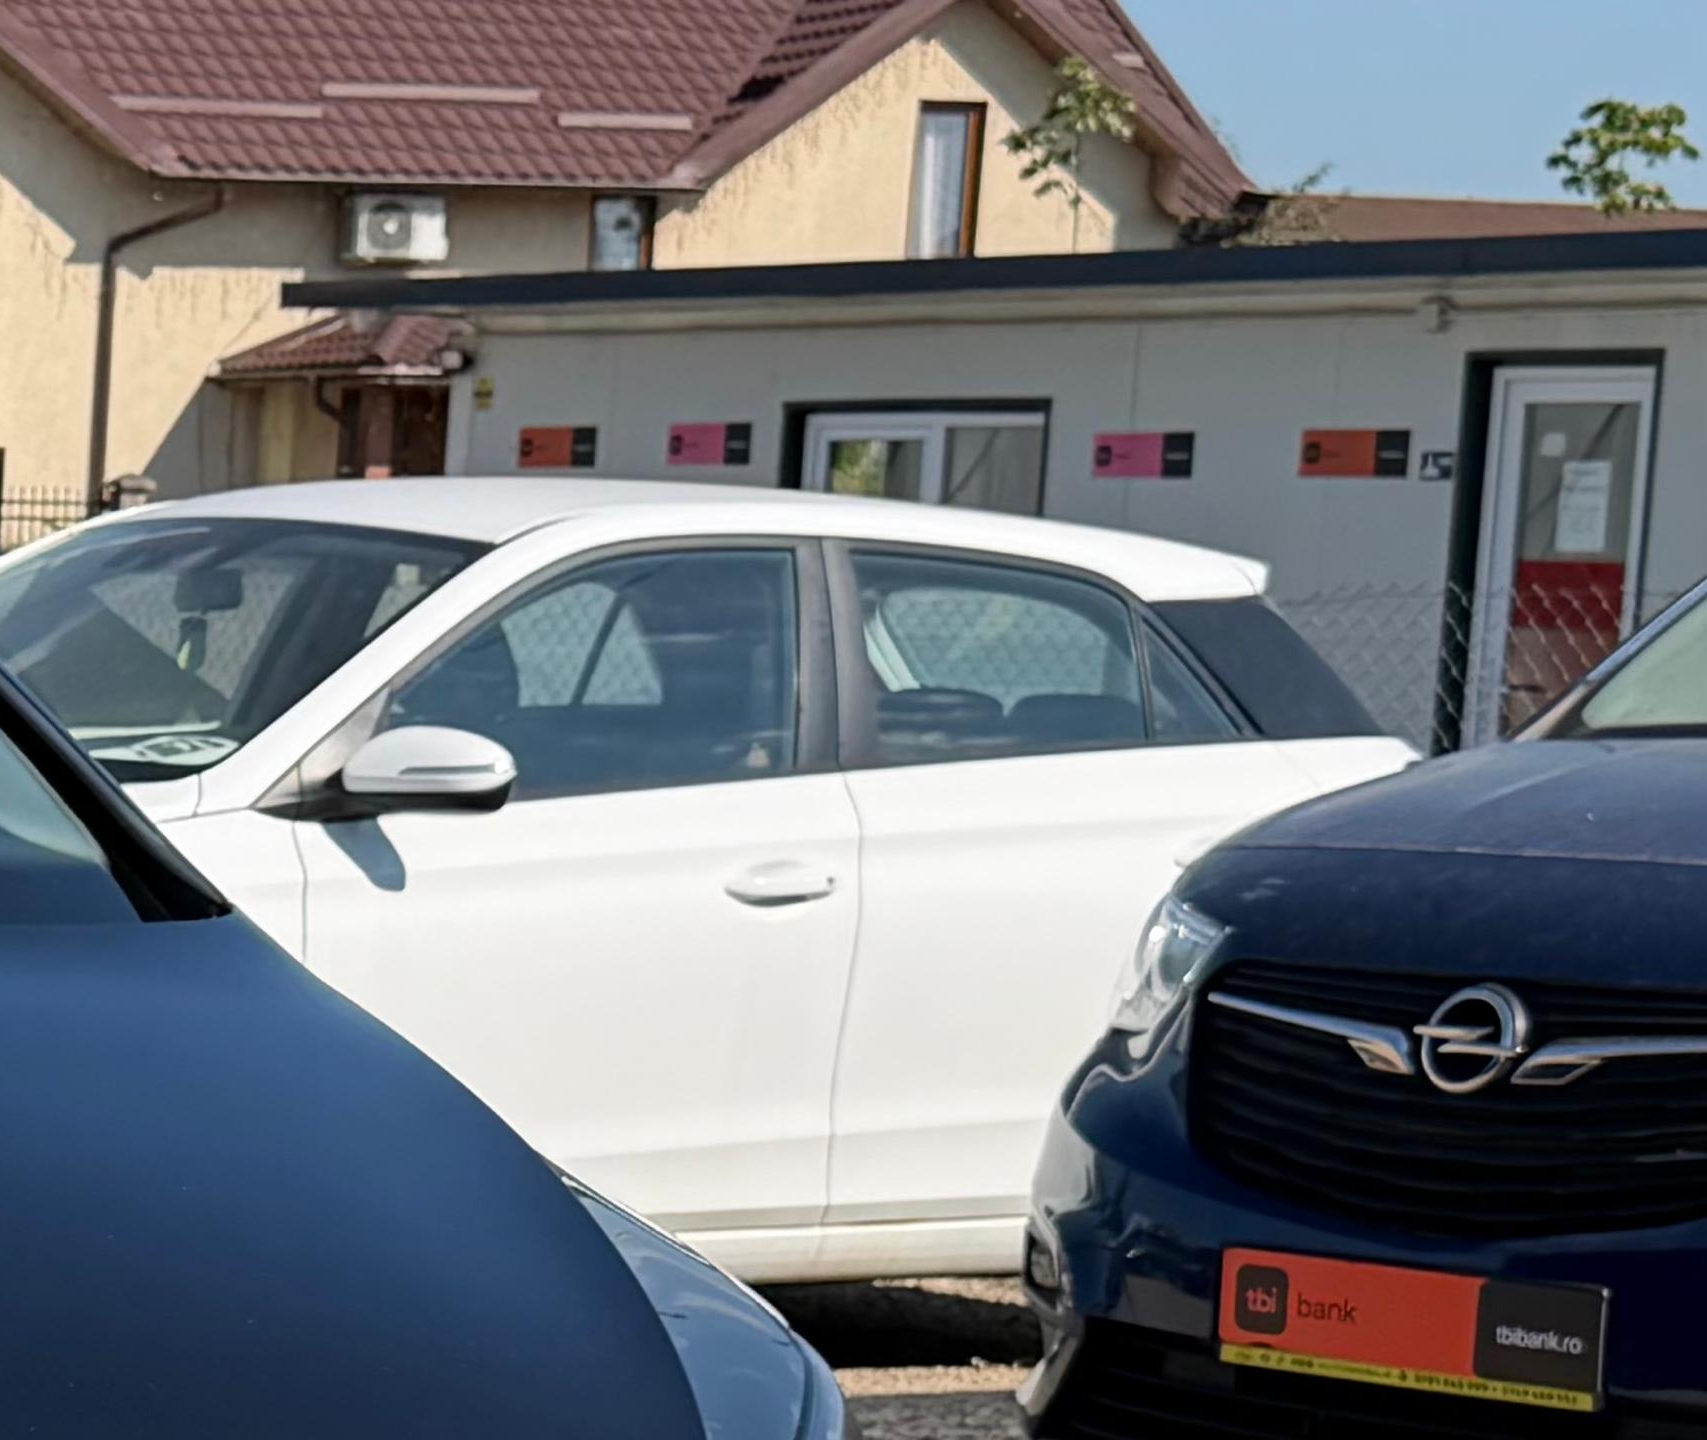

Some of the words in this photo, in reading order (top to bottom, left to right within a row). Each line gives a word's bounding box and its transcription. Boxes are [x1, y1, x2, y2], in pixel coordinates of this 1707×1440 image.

[1247, 1287, 1277, 1314] tbi
[1297, 1292, 1357, 1324] bank
[1495, 1325, 1583, 1355] tbibank.ro
